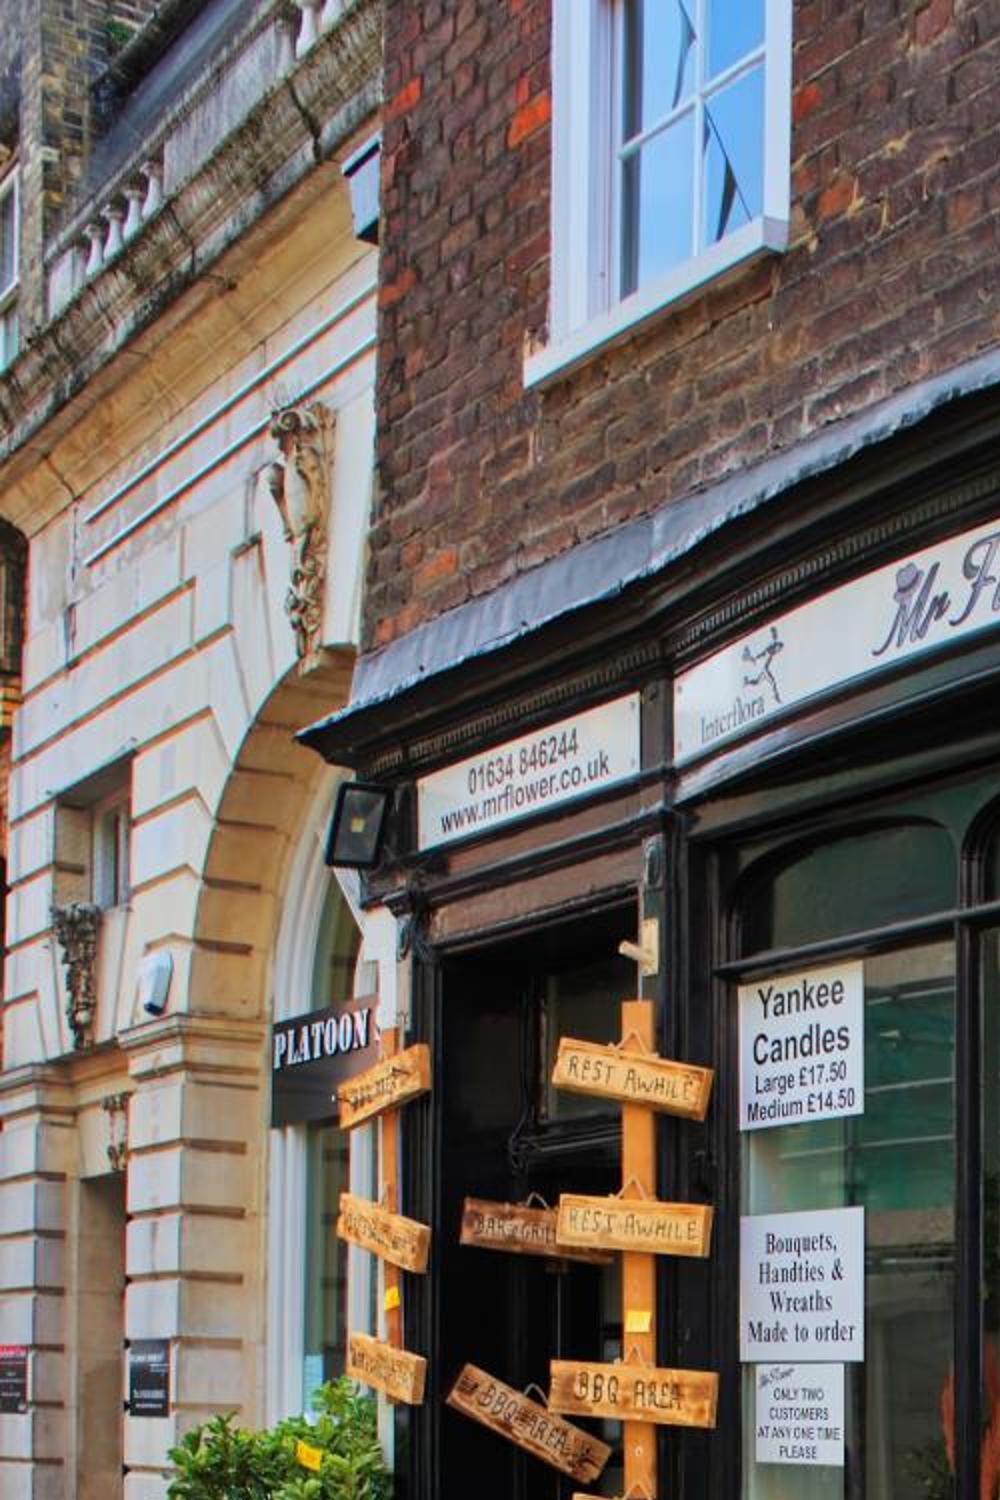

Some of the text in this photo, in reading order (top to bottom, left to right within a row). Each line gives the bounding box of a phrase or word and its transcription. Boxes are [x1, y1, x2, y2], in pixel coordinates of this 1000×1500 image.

[872, 562, 951, 656] Mr
[701, 696, 765, 743] Interflora
[467, 727, 579, 795] 01634 846244
[441, 750, 609, 833] www.mrflower.co.uk
[758, 979, 845, 1020] Yankee
[273, 1008, 370, 1069] PLATOON
[753, 1023, 850, 1066] Candles
[567, 1055, 694, 1102] REST AWHILE
[755, 1060, 847, 1095] Large £17.50
[747, 1087, 855, 1123] Medium £14.50
[569, 1208, 699, 1242] REST AWHILE
[759, 1257, 844, 1284] Handties &
[769, 1289, 833, 1313] Wreaths
[748, 1319, 856, 1343] Made to order
[575, 1371, 682, 1411] BBQ AREA
[801, 1387, 825, 1401] TWO
[769, 1407, 829, 1420] CUSTOMERS
[779, 1445, 817, 1459] PLEASE
